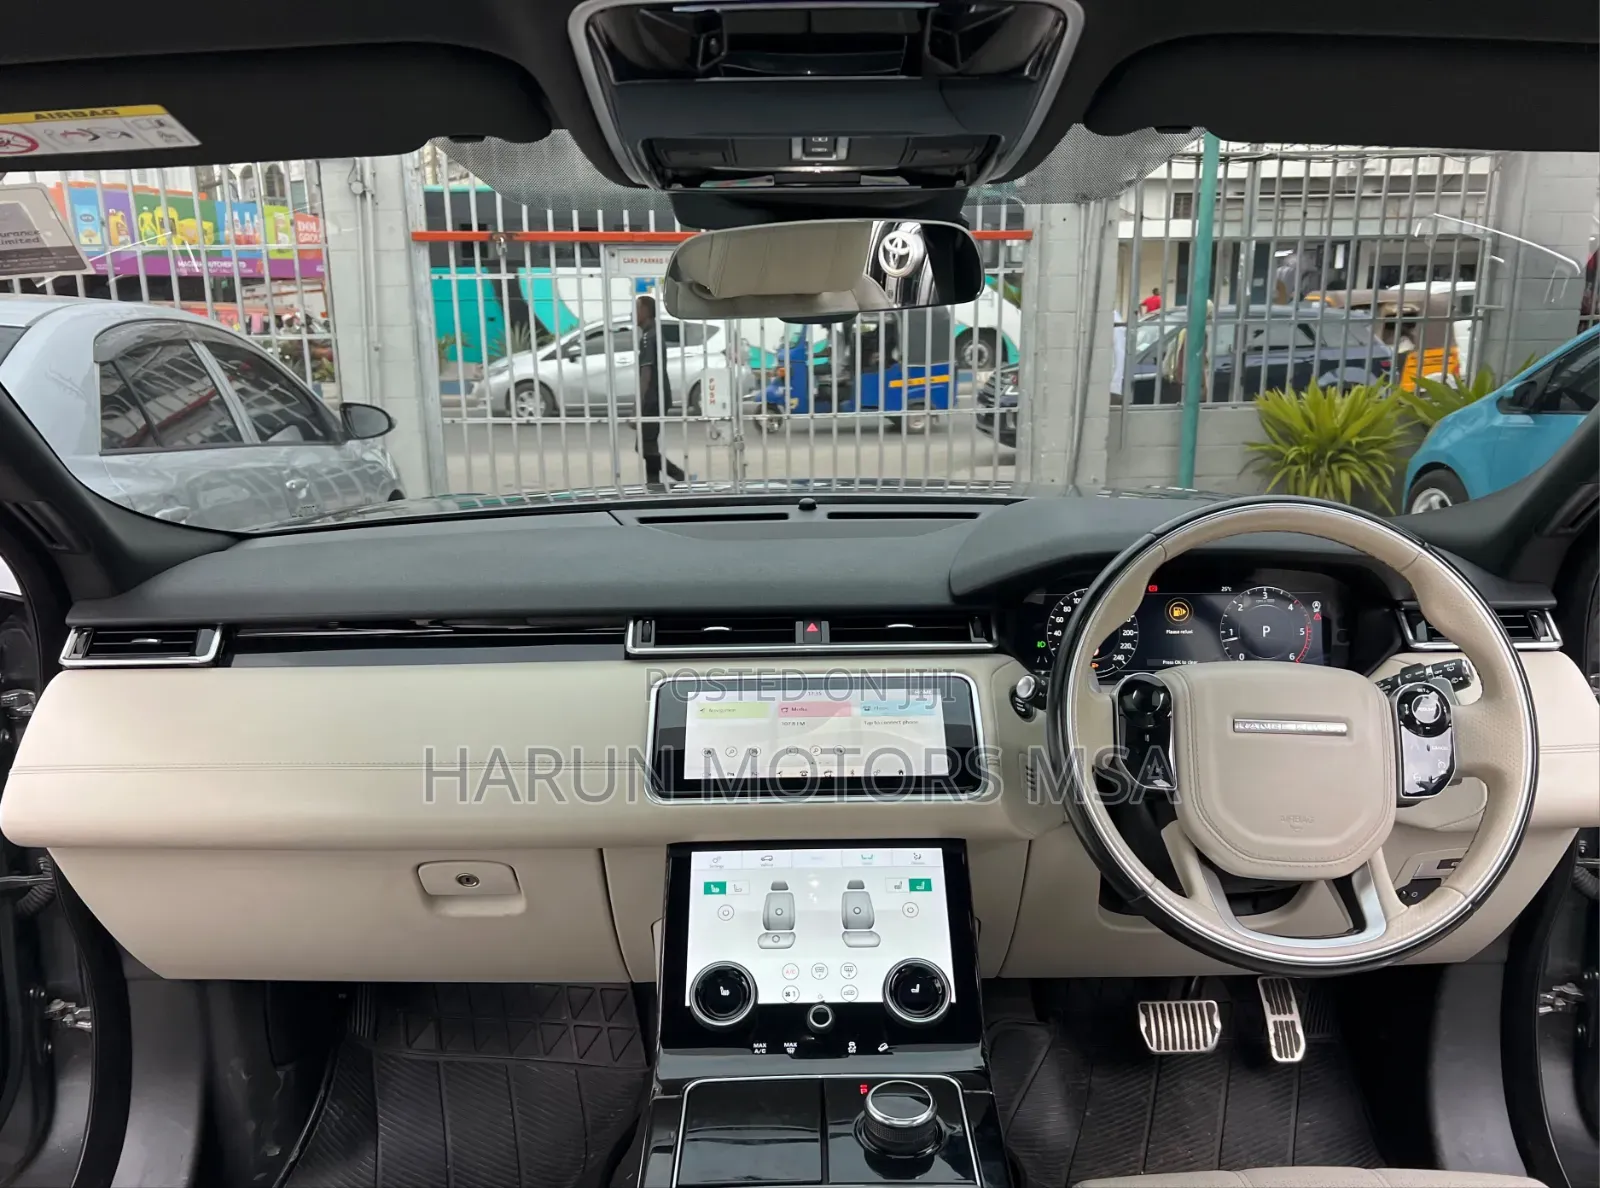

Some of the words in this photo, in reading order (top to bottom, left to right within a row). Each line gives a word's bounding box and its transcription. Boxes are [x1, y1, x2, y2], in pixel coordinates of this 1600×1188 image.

[34, 108, 119, 120] AIRBAG
[708, 377, 716, 405] PUSH
[1262, 591, 1268, 599] 3
[1237, 603, 1244, 611] 2
[1287, 603, 1294, 611] 4
[1228, 628, 1234, 636] 1
[1262, 625, 1271, 638] P
[1299, 628, 1305, 636] 5
[1238, 653, 1245, 661] 0
[1289, 653, 1295, 661] 6
